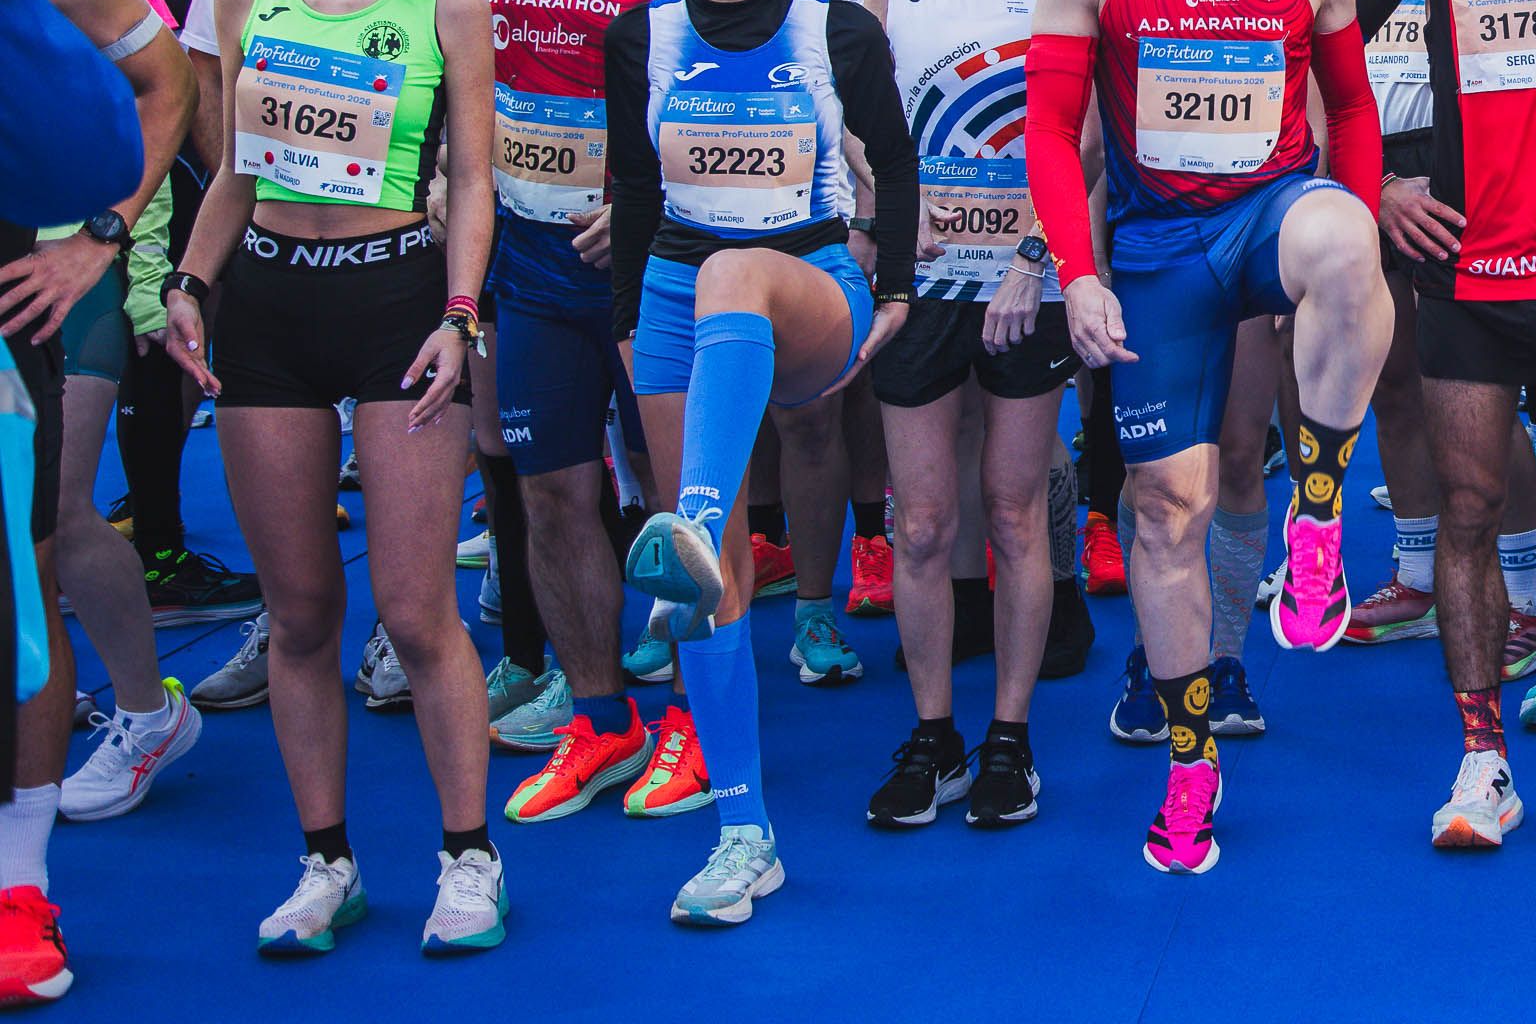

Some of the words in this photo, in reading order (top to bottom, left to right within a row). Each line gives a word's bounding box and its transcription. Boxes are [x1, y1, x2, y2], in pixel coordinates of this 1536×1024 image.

[1138, 18, 1174, 32] A.D.
[1180, 17, 1284, 32] MARATHON
[511, 20, 588, 52] alquiber
[251, 42, 321, 68] ProFuturo
[1143, 42, 1214, 60] ProFuturo
[1368, 55, 1409, 65] ALEJANDRO
[912, 85, 922, 98] la
[918, 40, 981, 86] educación
[1163, 75, 1197, 84] Carrera
[1198, 77, 1243, 85] ProFuturo
[1506, 76, 1533, 85] MADRID
[262, 77, 296, 91] Carrera
[298, 84, 346, 101] ProFuturo
[346, 94, 371, 106] 2026
[667, 95, 736, 114] ProFuturo
[1164, 91, 1252, 122] 32101
[261, 96, 358, 142] 31625
[562, 132, 585, 140] 2026
[677, 129, 684, 137] X
[685, 129, 720, 138] Carrera
[722, 130, 769, 139] ProFuturo
[769, 130, 794, 138] 2026
[283, 149, 319, 169] SILVIA
[503, 137, 576, 174] 32520
[688, 146, 786, 177] 32223
[1187, 160, 1214, 169] MADRID
[279, 173, 301, 186] MADRID
[933, 191, 963, 199] Carrera
[965, 192, 1006, 200] ProFuturo
[716, 215, 745, 224] MADRID
[290, 237, 393, 267] NIKE
[957, 249, 994, 260] LAURA
[954, 269, 980, 278] MADRID
[1122, 400, 1167, 420] alquiber
[1120, 418, 1167, 440] ADM
